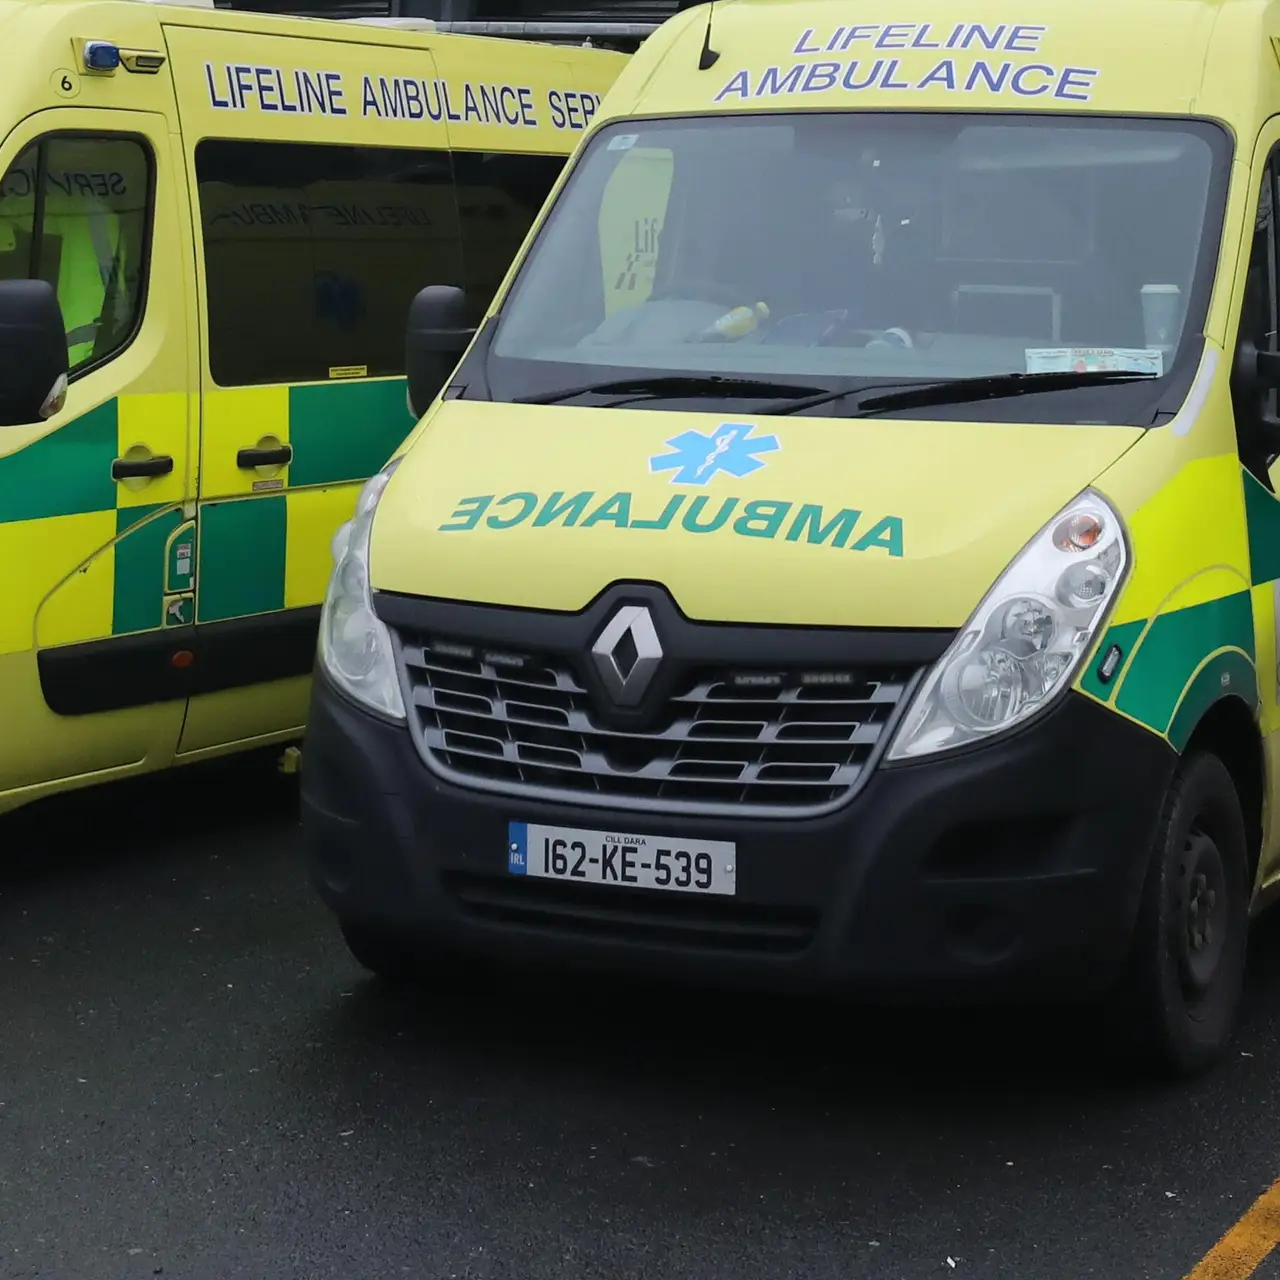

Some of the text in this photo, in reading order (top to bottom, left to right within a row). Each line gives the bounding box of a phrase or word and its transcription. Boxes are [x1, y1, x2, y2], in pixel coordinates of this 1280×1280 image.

[793, 23, 1047, 54] LIFELINE
[61, 76, 73, 91] 6
[205, 63, 348, 116] LIFELINE
[362, 76, 538, 127] AMBULANCE
[714, 59, 1099, 102] AMBULANCE
[605, 835, 647, 847] CILL DARA
[510, 851, 526, 865] IRL
[543, 836, 713, 890] 162-KE-539
